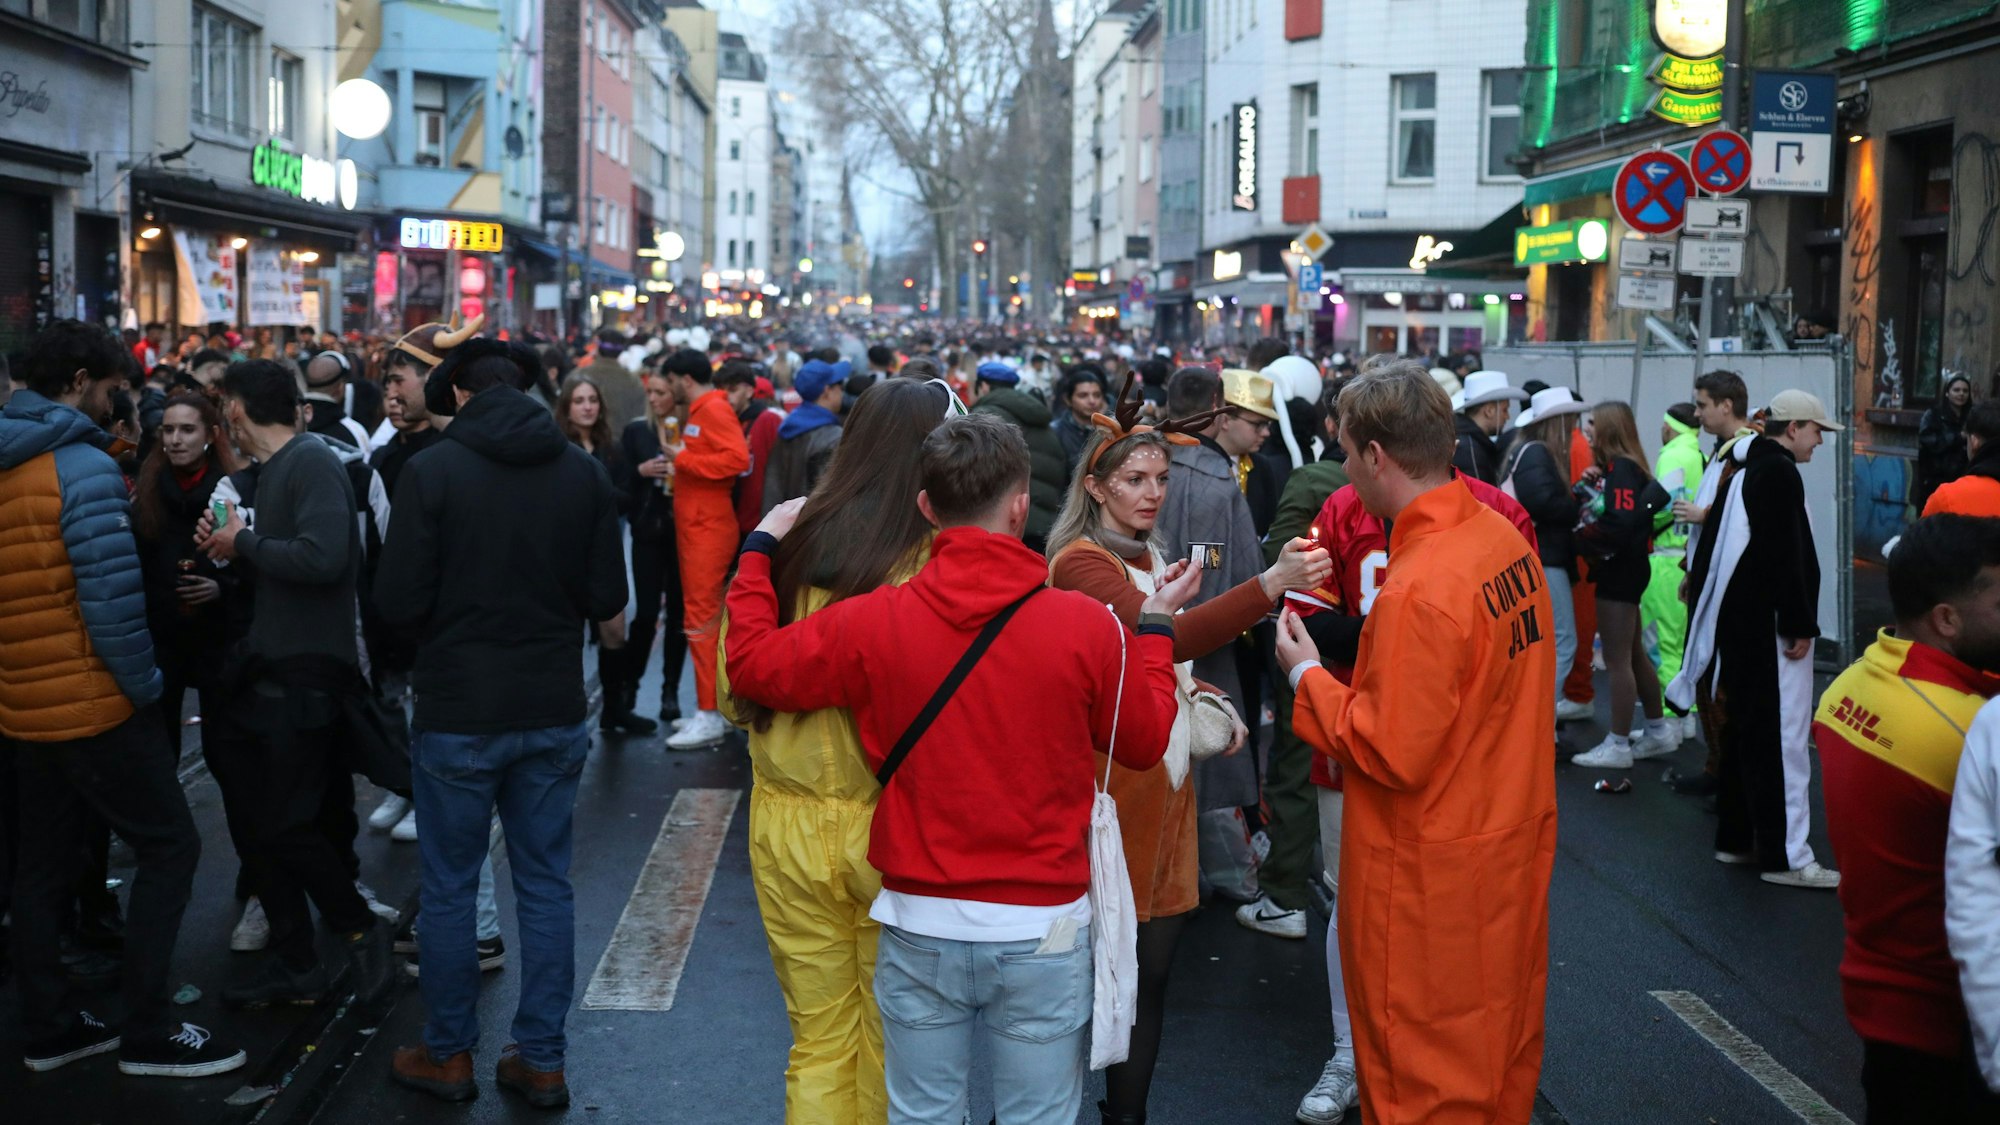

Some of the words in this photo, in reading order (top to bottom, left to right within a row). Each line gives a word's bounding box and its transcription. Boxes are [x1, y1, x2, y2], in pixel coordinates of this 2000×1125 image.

[1692, 63, 1718, 74] OMA
[1614, 488, 1635, 511] 15
[1832, 696, 1882, 743] DHL
